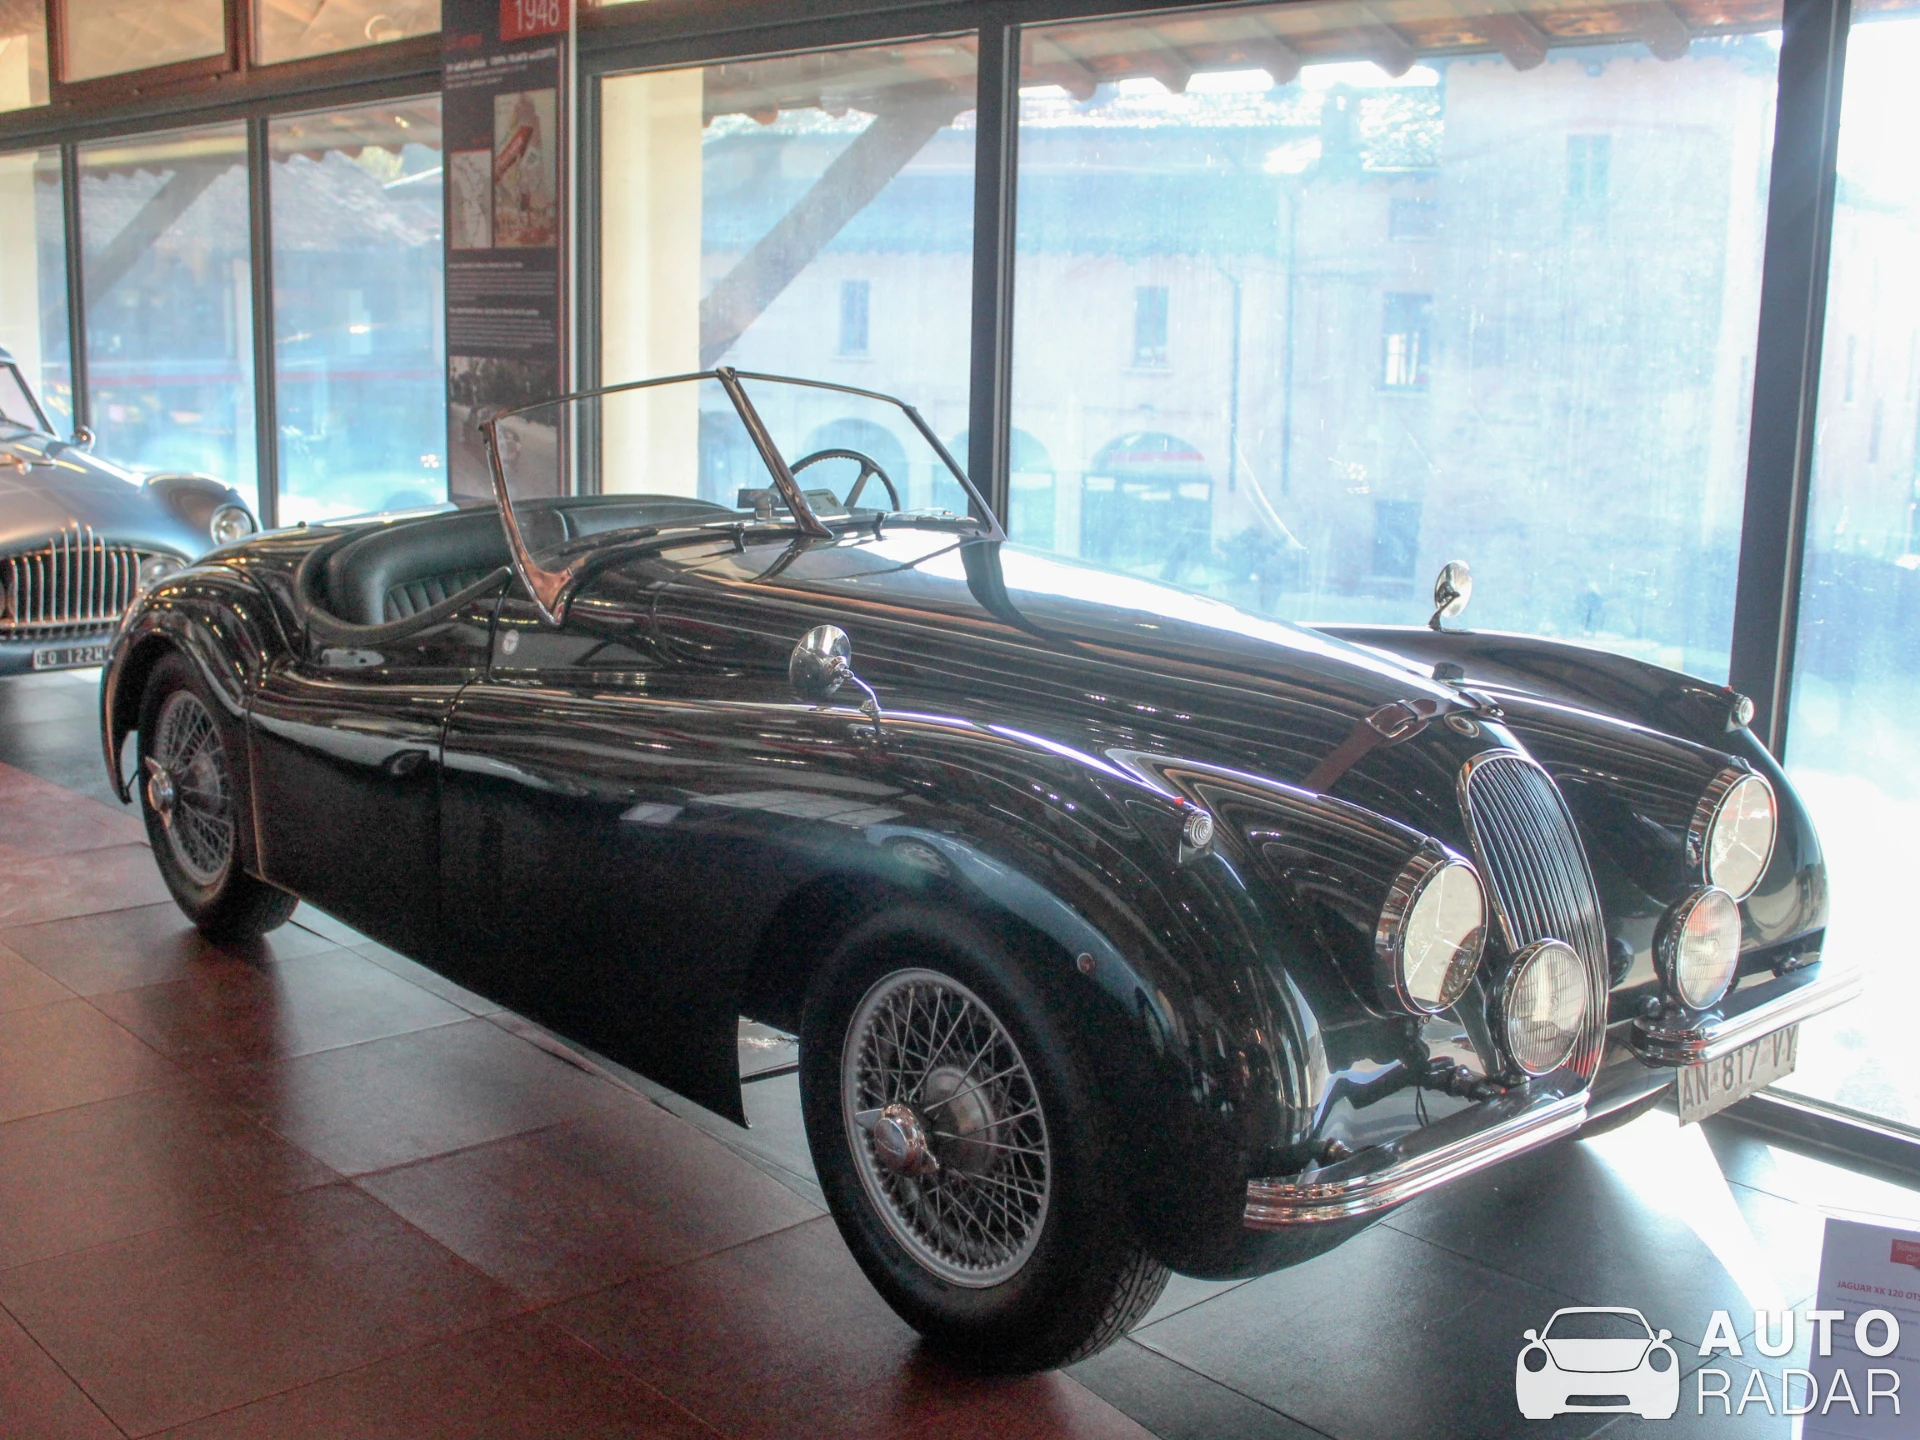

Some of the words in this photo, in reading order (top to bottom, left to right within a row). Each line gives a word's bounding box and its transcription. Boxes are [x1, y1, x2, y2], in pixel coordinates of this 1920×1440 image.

[514, 0, 561, 31] 1948
[1682, 1061, 1710, 1111] AN
[1723, 1040, 1761, 1091] 817
[1772, 1023, 1798, 1068] VY
[1837, 1280, 1872, 1293] JAGUAR
[1874, 1286, 1886, 1295] XK
[1888, 1289, 1904, 1298] 120
